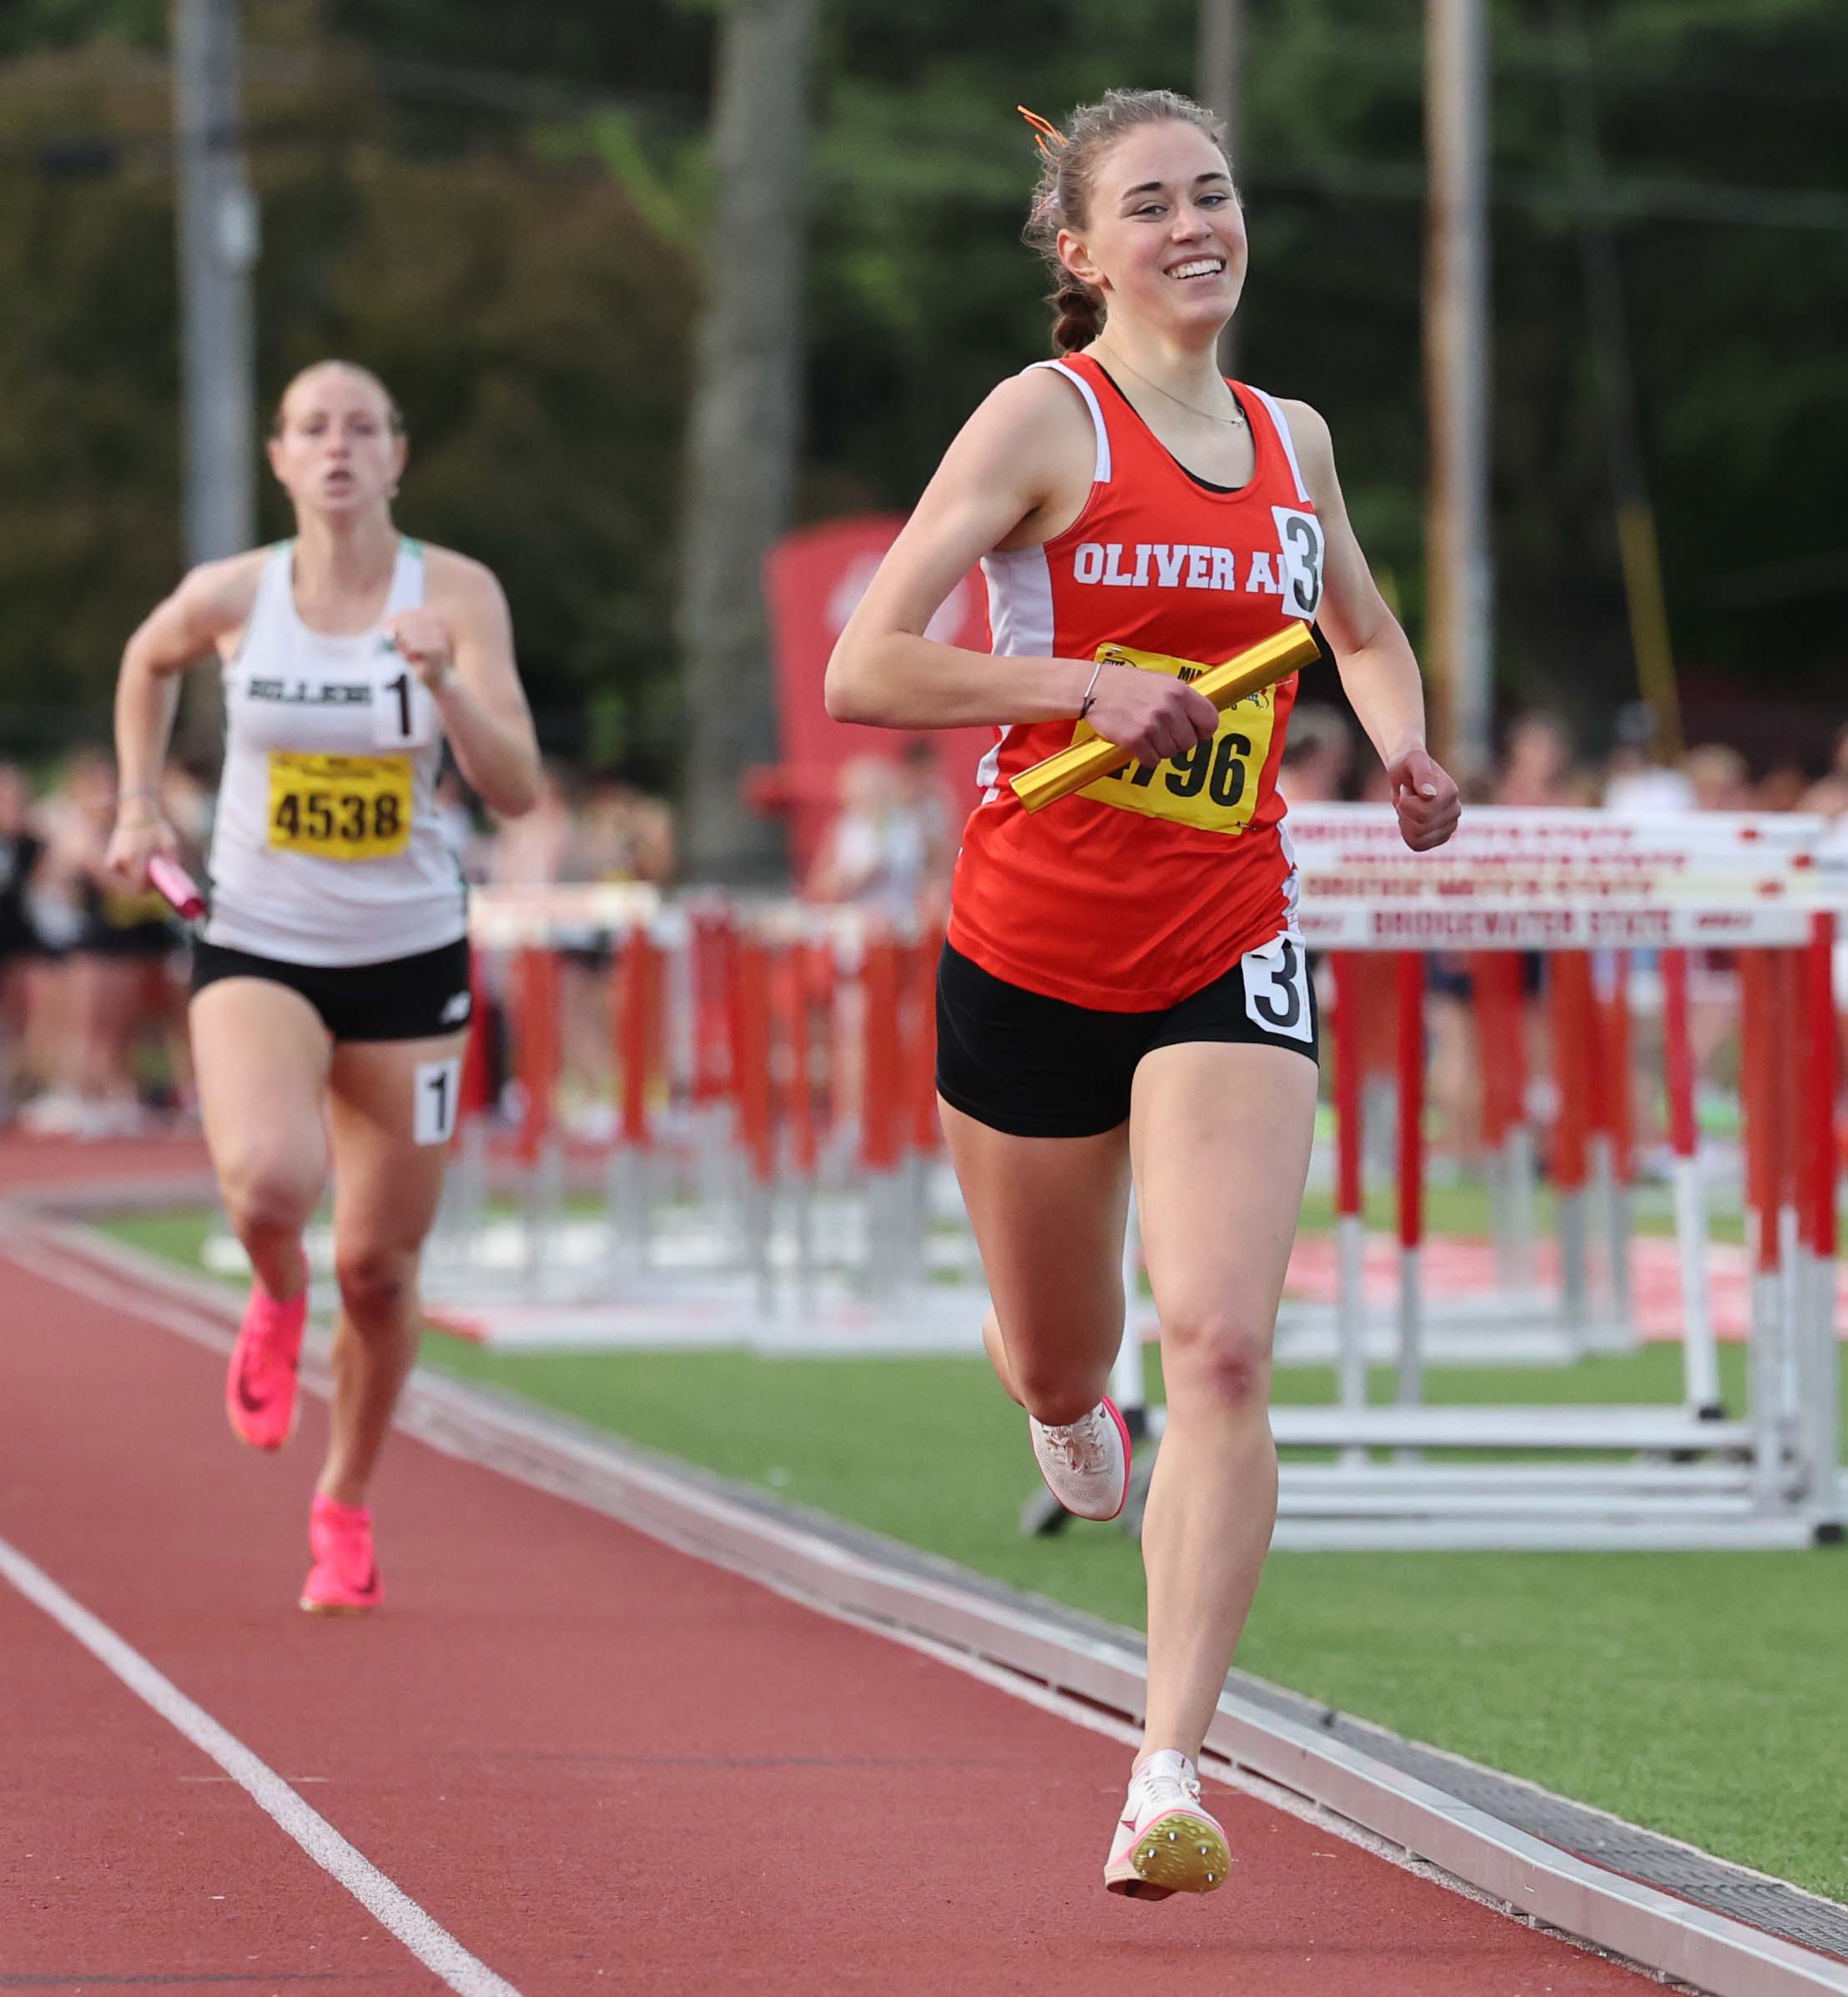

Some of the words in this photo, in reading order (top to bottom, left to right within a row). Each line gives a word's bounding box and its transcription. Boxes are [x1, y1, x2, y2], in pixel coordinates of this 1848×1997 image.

[1074, 543, 1235, 591] OLIVER
[1287, 516, 1319, 613] 3
[386, 673, 411, 737] 1
[276, 792, 401, 843] 4538
[1253, 938, 1301, 1028] 3
[427, 1071, 447, 1131] 1
